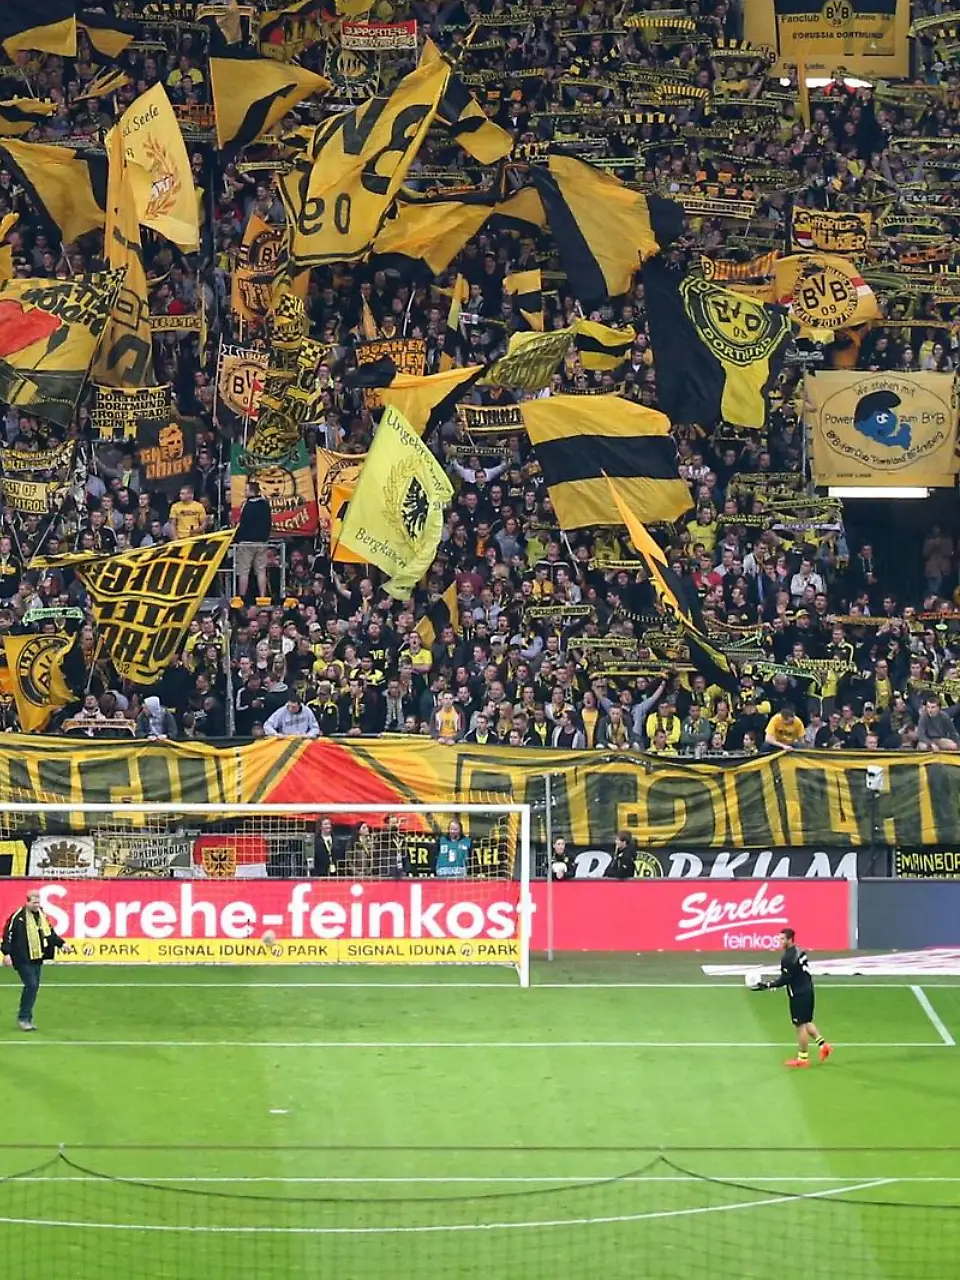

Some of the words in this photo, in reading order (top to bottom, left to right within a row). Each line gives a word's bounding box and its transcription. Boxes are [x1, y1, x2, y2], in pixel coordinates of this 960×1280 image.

[133, 104, 159, 131] Seele
[803, 275, 848, 310] BVB
[97, 391, 166, 402] DORTMUND
[97, 400, 168, 411] DORTMUND
[678, 882, 786, 931] Sprehe
[723, 931, 782, 949] feinkos
[99, 944, 140, 957] PARK
[157, 944, 216, 957] SIGNAL
[218, 944, 268, 957] IDUNA
[288, 945, 329, 957] PARK
[347, 944, 405, 957] SIGNAL
[409, 944, 457, 957] IDUNA
[478, 944, 519, 956] PARK
